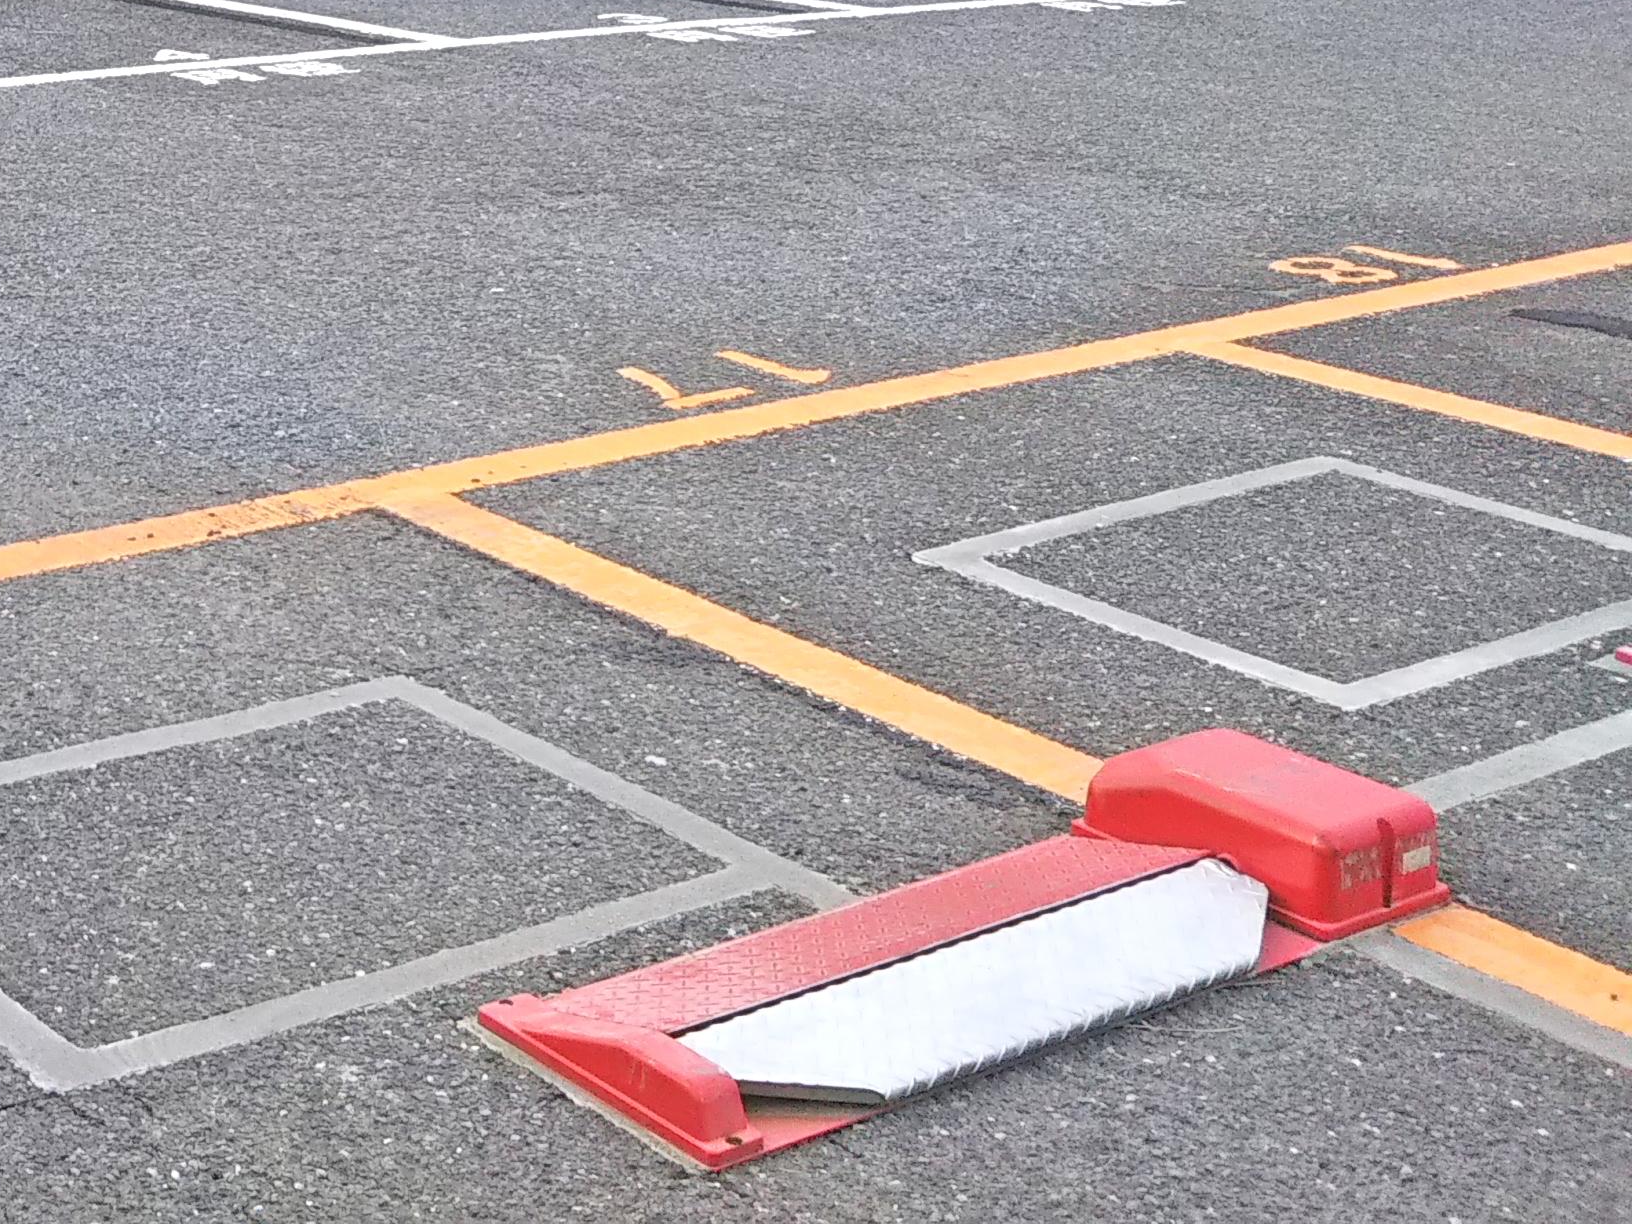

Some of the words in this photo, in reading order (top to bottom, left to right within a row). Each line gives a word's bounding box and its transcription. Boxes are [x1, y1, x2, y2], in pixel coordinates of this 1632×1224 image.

[153, 49, 210, 62] 4
[1269, 244, 1464, 284] 18
[616, 350, 832, 409] 17
